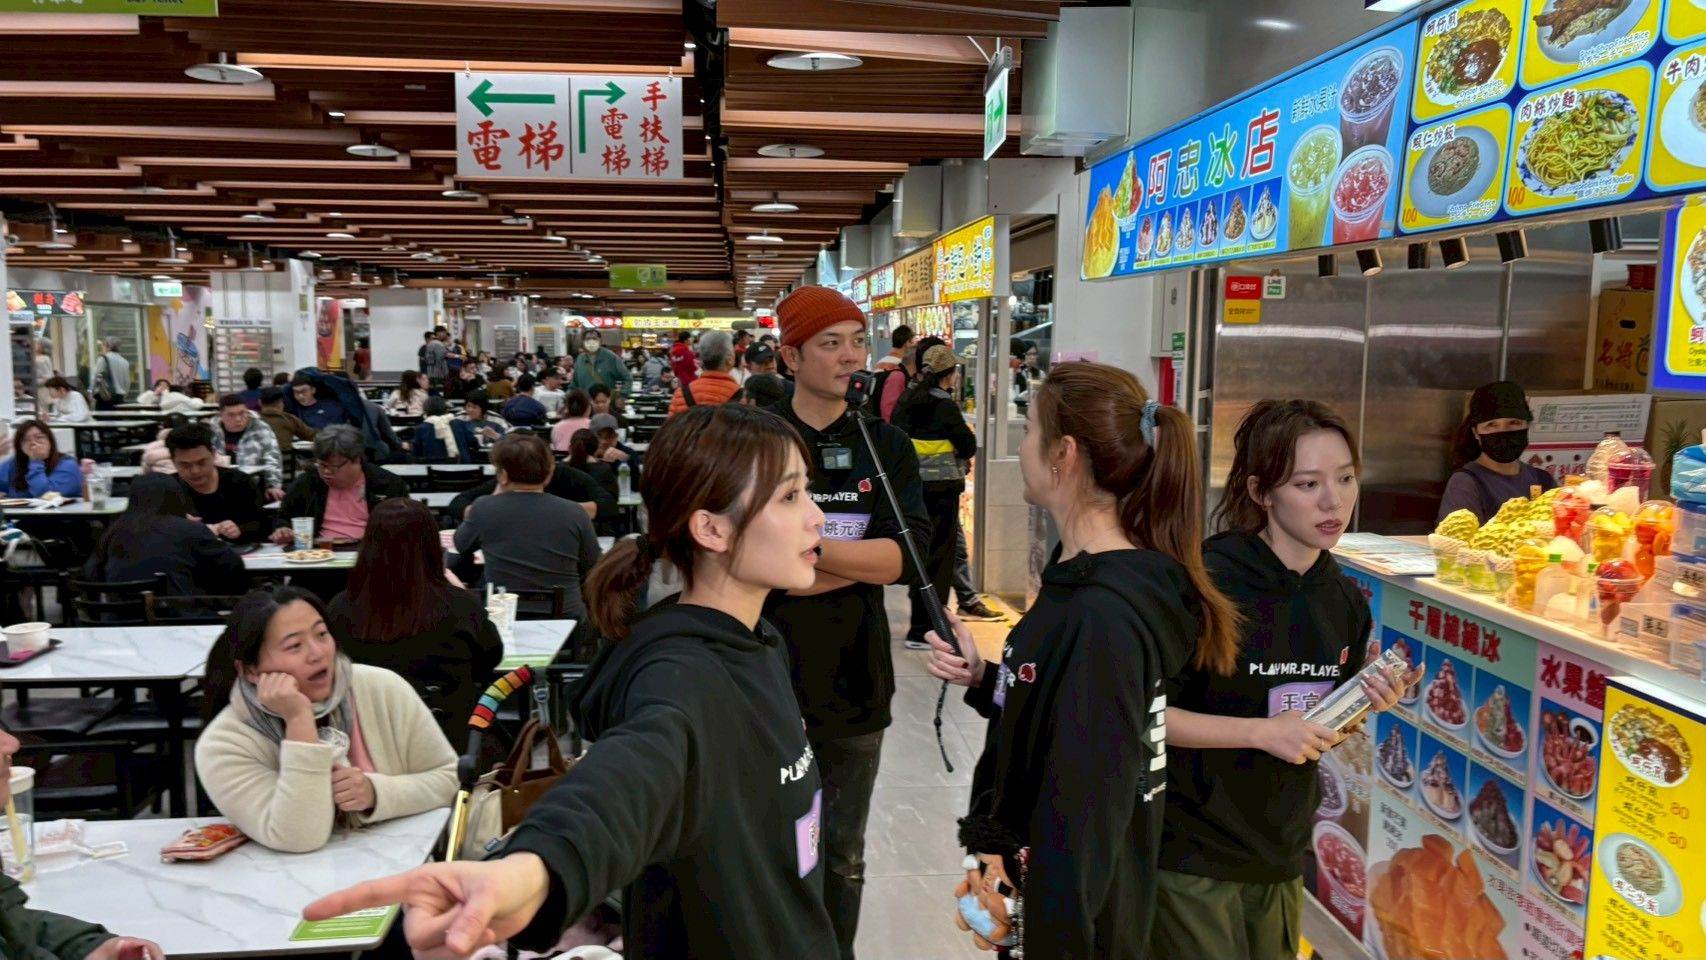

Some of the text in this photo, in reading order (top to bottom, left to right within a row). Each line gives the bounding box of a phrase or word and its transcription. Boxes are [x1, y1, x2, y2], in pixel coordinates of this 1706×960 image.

[1664, 53, 1706, 84] 牛肉
[467, 119, 564, 172] 電梯
[601, 107, 632, 176] 電梯
[639, 80, 671, 177] 手扶梯
[1146, 108, 1281, 208] 阿忠冰店
[1402, 207, 1418, 223] 100
[1508, 187, 1526, 207] 100
[1657, 931, 1683, 953] 100
